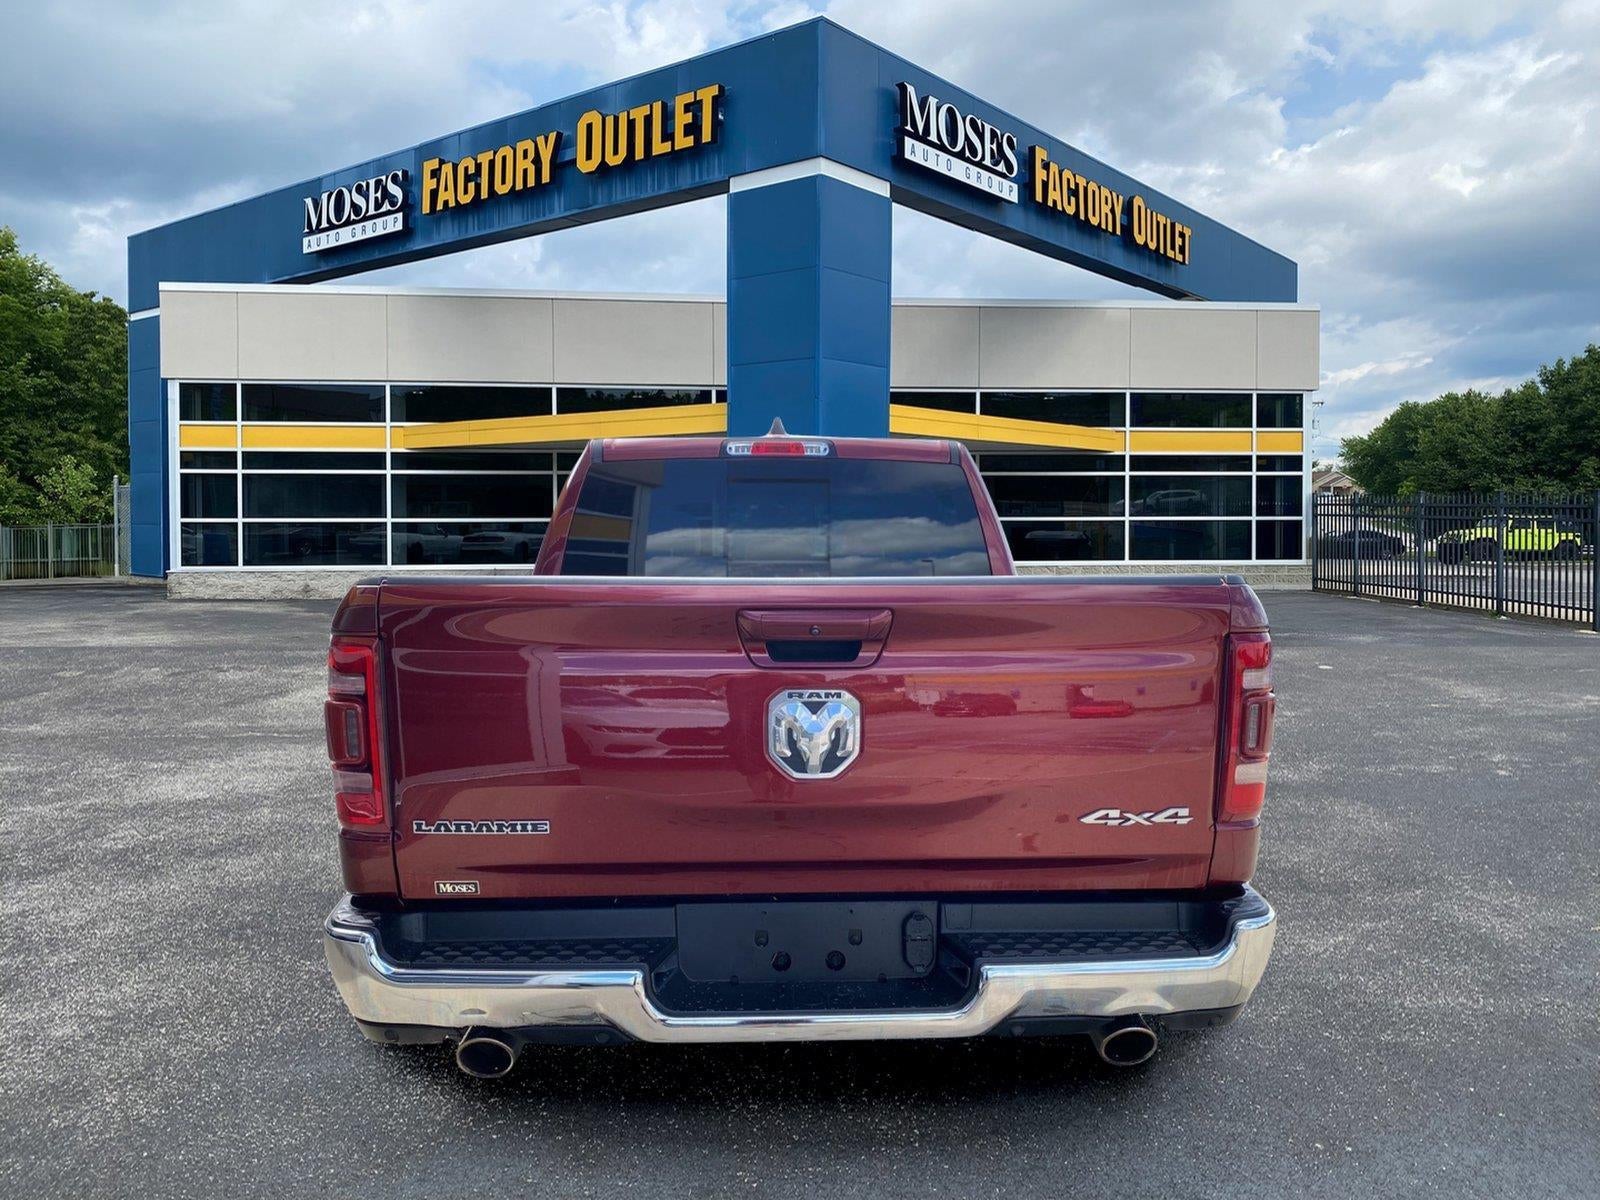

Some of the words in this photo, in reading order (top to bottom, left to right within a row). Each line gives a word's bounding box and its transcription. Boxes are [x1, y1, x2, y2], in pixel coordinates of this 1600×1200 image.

[422, 130, 560, 214] FACTORY
[576, 84, 722, 175] OUTLET
[900, 82, 1018, 178] MOSES
[909, 142, 953, 172] AUTO
[965, 166, 1014, 195] GROUP
[303, 170, 403, 233] MOSES
[1034, 145, 1124, 235] FACTORY
[1132, 195, 1192, 265] OUTLET
[306, 229, 341, 251] AUTO
[350, 216, 400, 239] GROUP
[787, 691, 842, 699] RAM
[413, 820, 550, 834] LARAMIE
